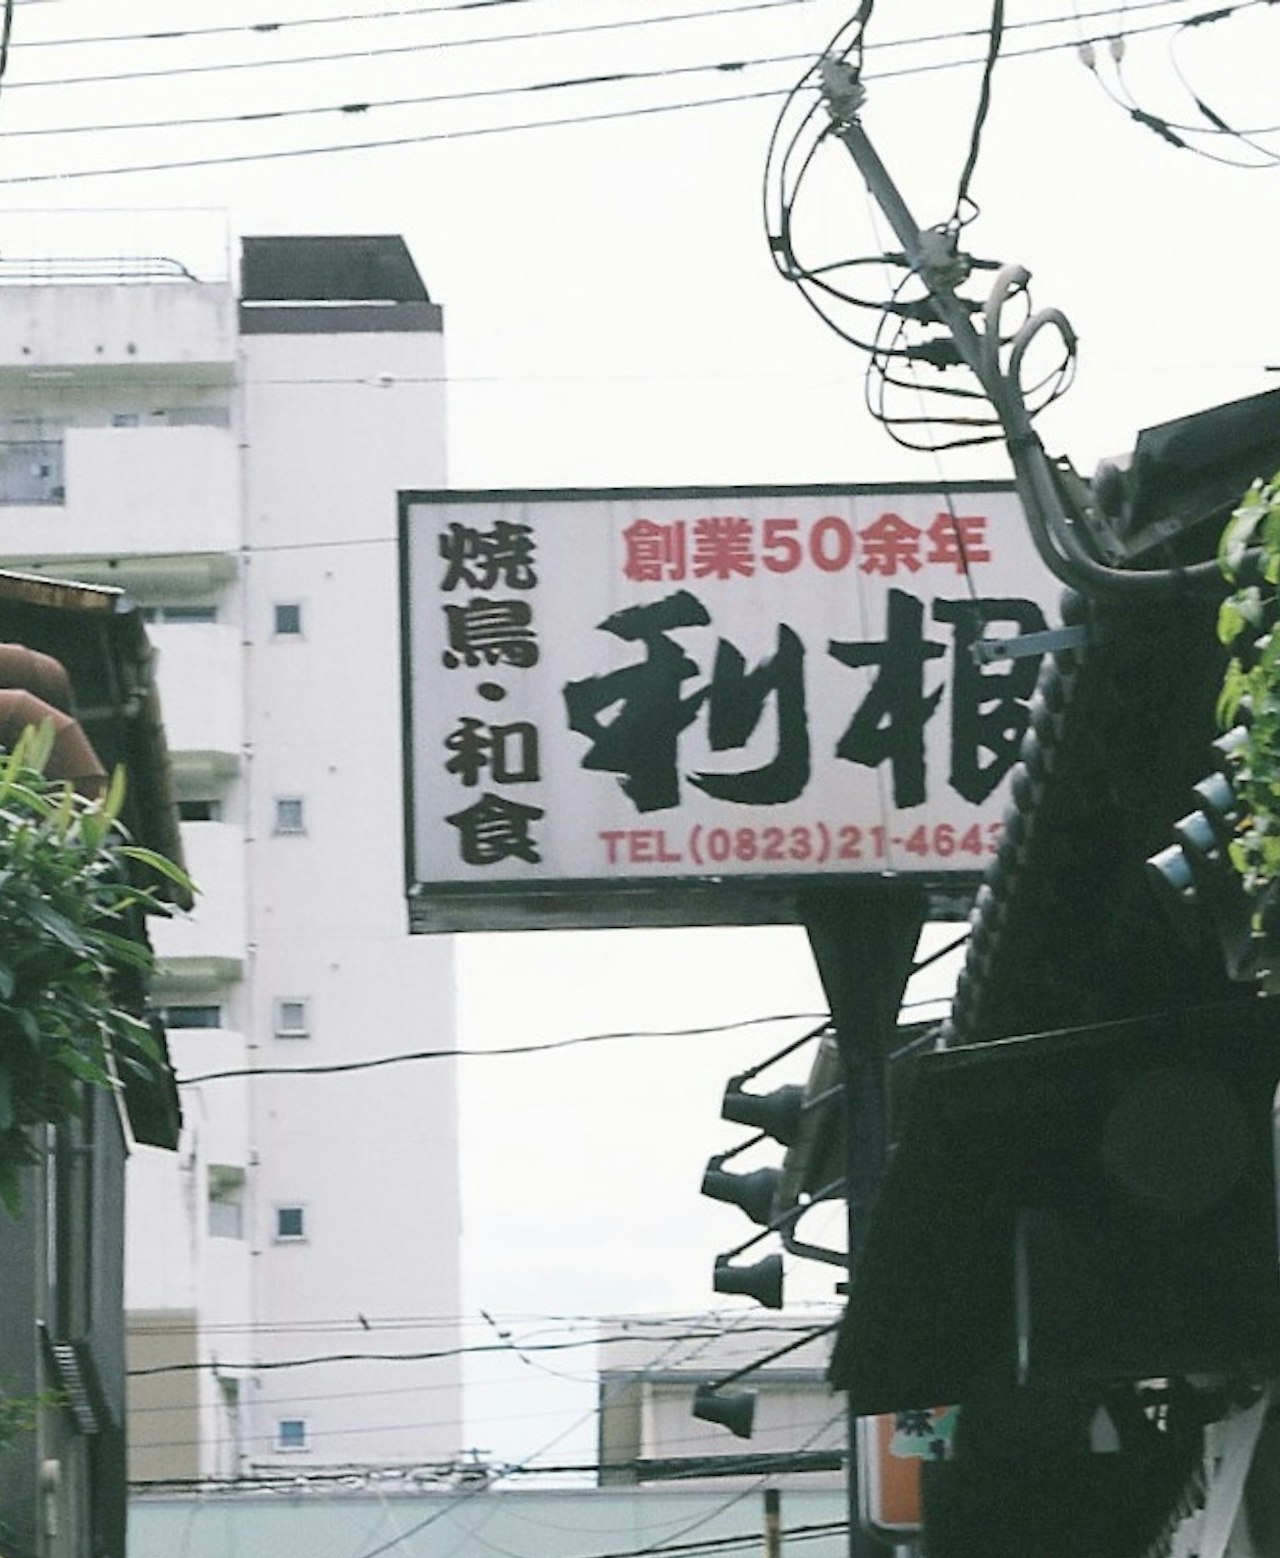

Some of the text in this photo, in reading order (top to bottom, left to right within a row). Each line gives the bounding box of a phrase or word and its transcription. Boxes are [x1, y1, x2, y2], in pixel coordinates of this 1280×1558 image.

[622, 513, 991, 582] 創業50余年
[438, 520, 545, 866] 焼鳥・和食
[563, 587, 1050, 813] 利根
